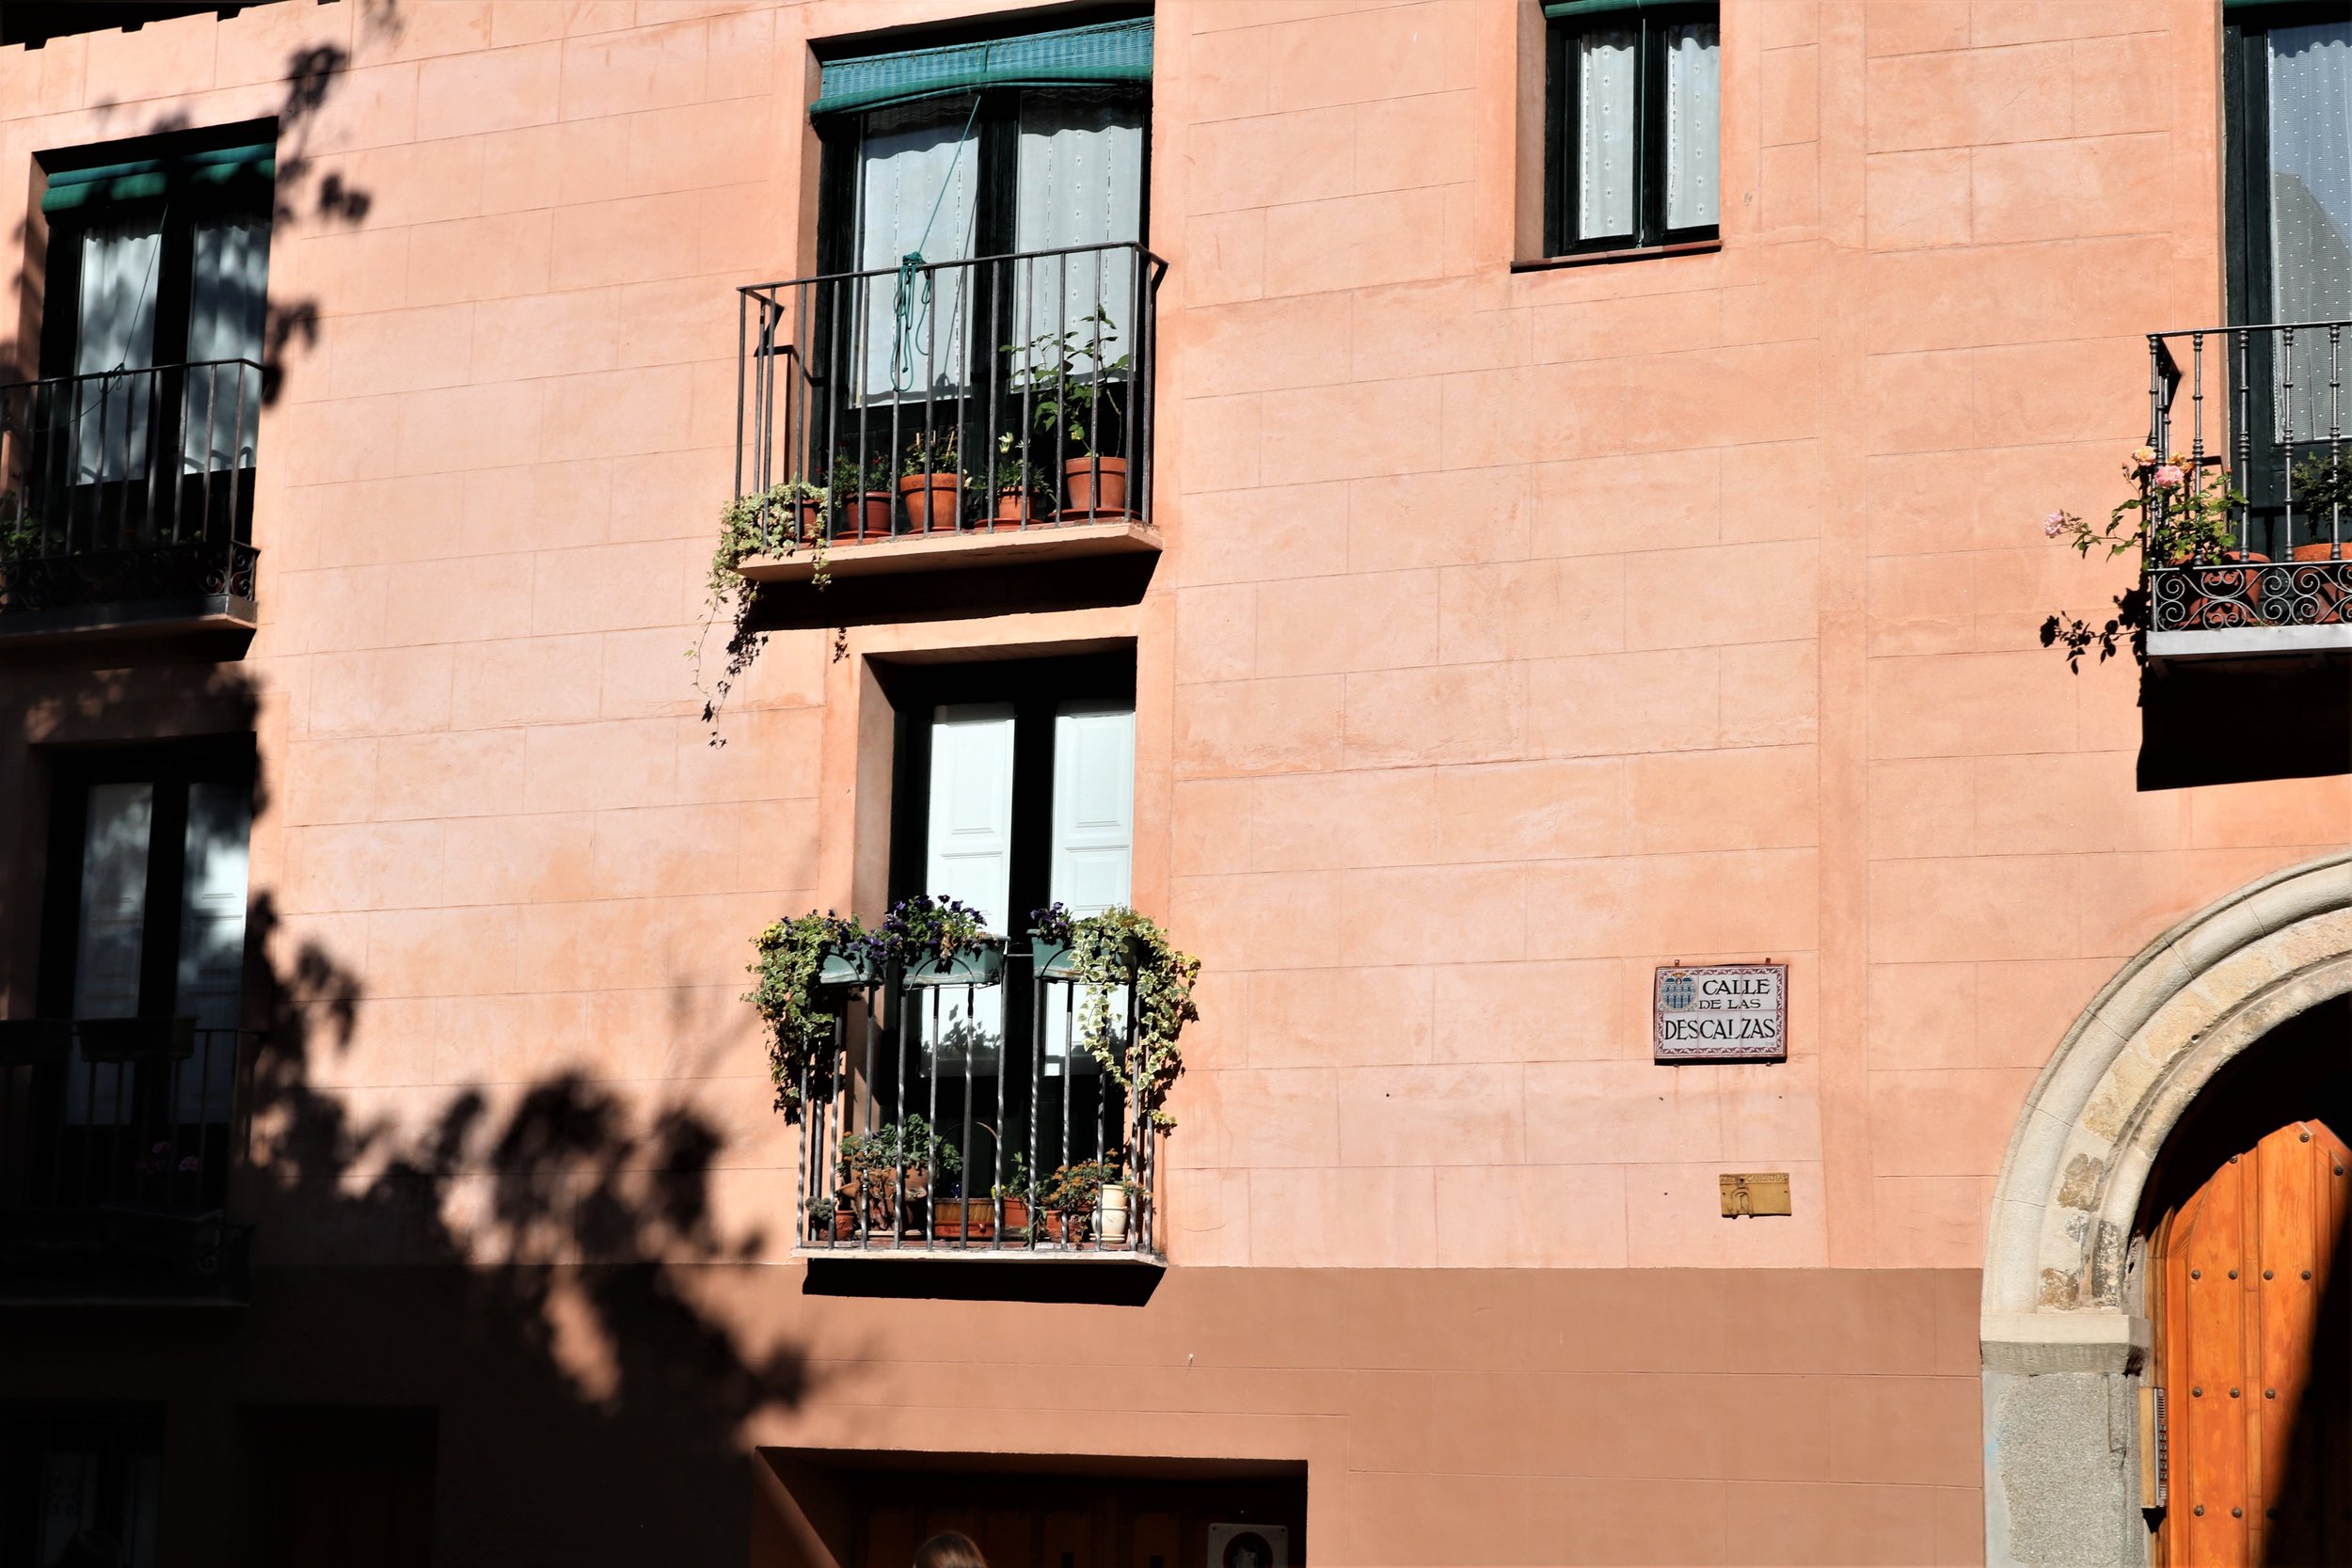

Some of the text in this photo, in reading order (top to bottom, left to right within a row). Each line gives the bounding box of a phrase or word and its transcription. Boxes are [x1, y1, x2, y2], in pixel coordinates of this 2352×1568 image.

[1702, 978, 1771, 995] CALLE
[1699, 998, 1761, 1009] DE LAS
[1664, 1018, 1776, 1040] DESCALZAS
